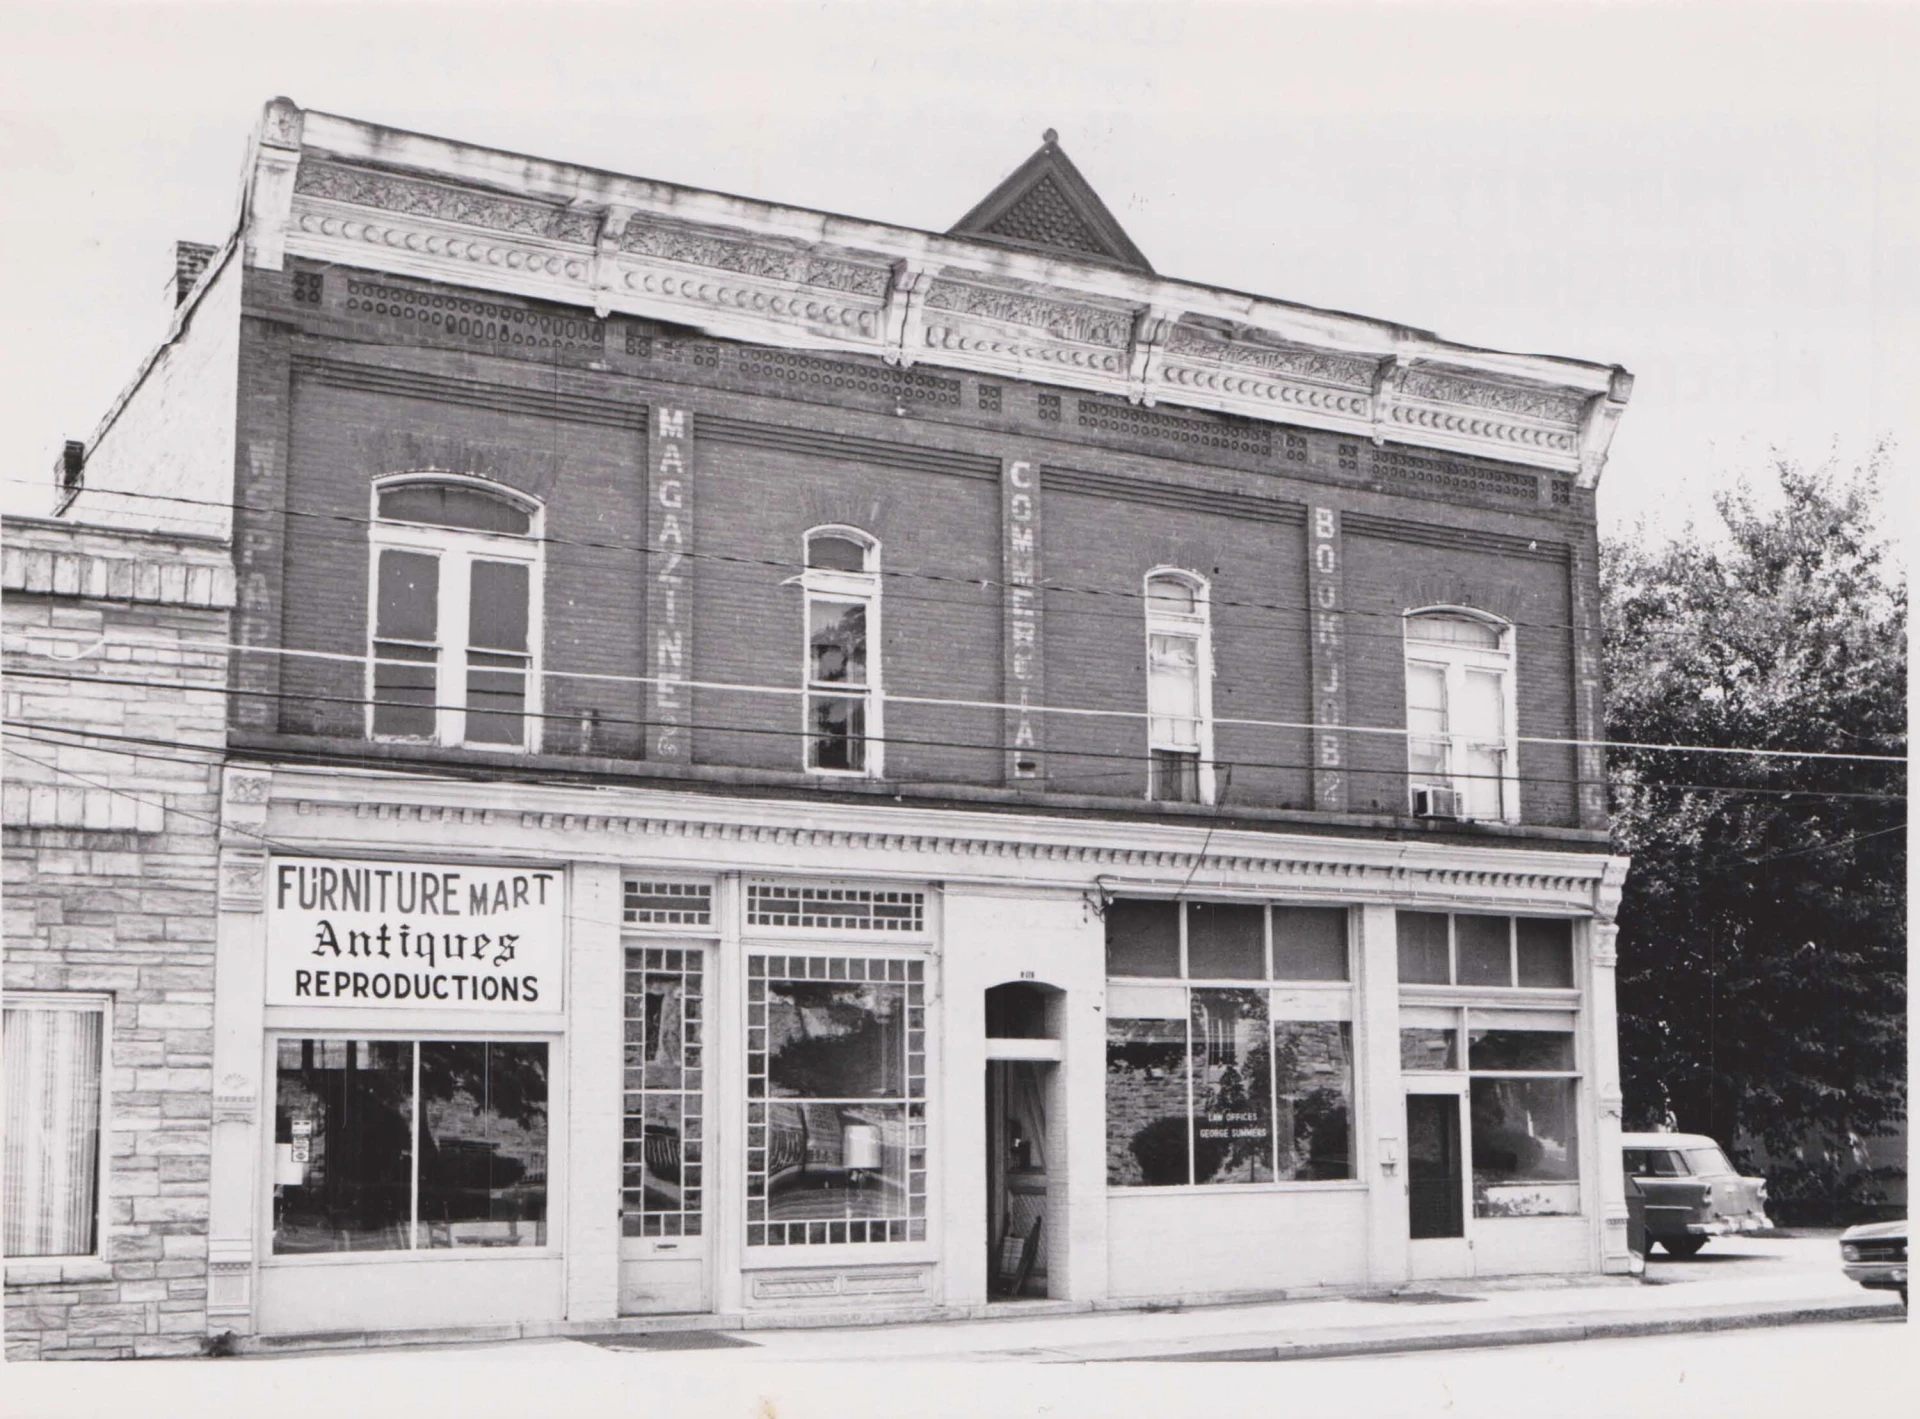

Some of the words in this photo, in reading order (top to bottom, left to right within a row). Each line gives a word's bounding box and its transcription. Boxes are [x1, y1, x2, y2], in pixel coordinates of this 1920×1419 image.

[1010, 461, 1036, 778] COMMERCIAL
[276, 865, 461, 916] FURNITURE
[469, 873, 554, 916] MART
[311, 920, 520, 968] Antiques
[295, 970, 539, 1002] REPRODUCTIONS
[1199, 1128, 1229, 1138] GEORGE
[1207, 1112, 1223, 1122] LAW
[1226, 1112, 1258, 1121] OFFICES
